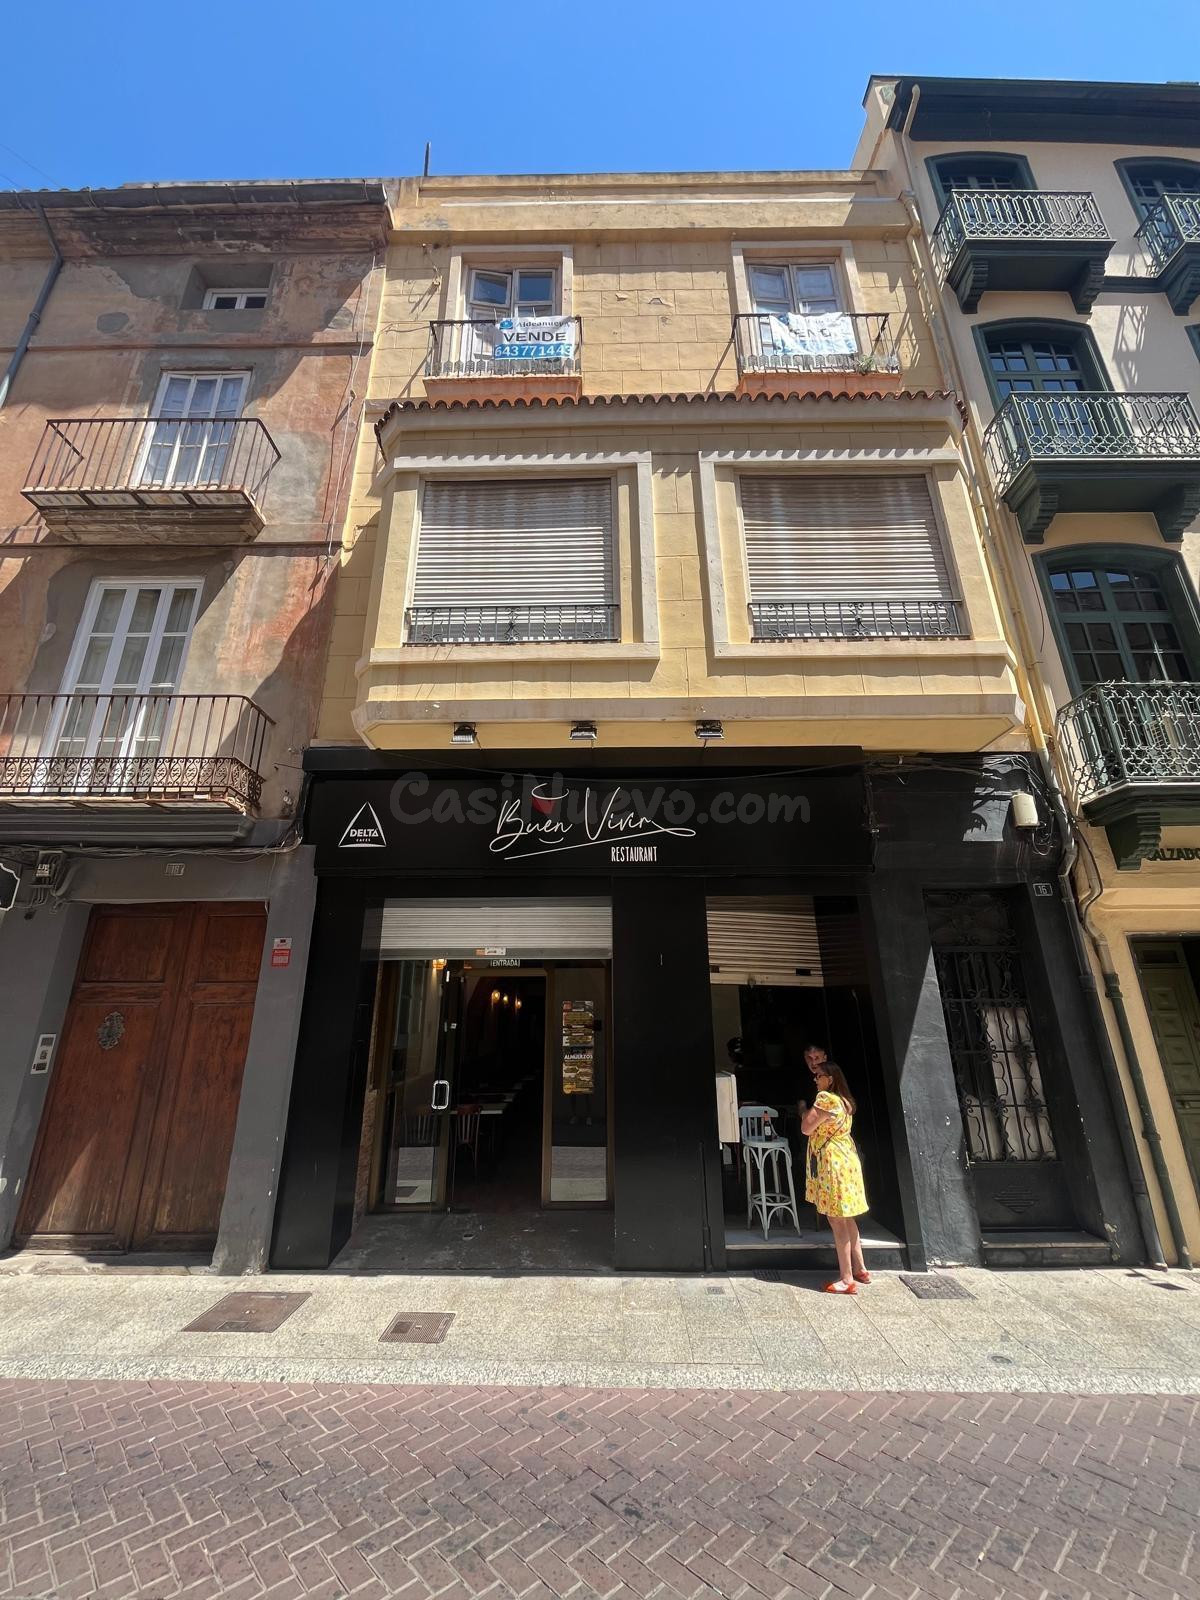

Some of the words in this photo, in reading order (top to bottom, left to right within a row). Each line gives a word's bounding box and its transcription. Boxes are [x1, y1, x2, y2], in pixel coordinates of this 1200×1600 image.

[503, 331, 567, 342] VENDE
[489, 799, 573, 852] Buen
[584, 786, 696, 841] Vivir
[350, 829, 379, 837] DELTA
[611, 846, 658, 863] RESTAURANT
